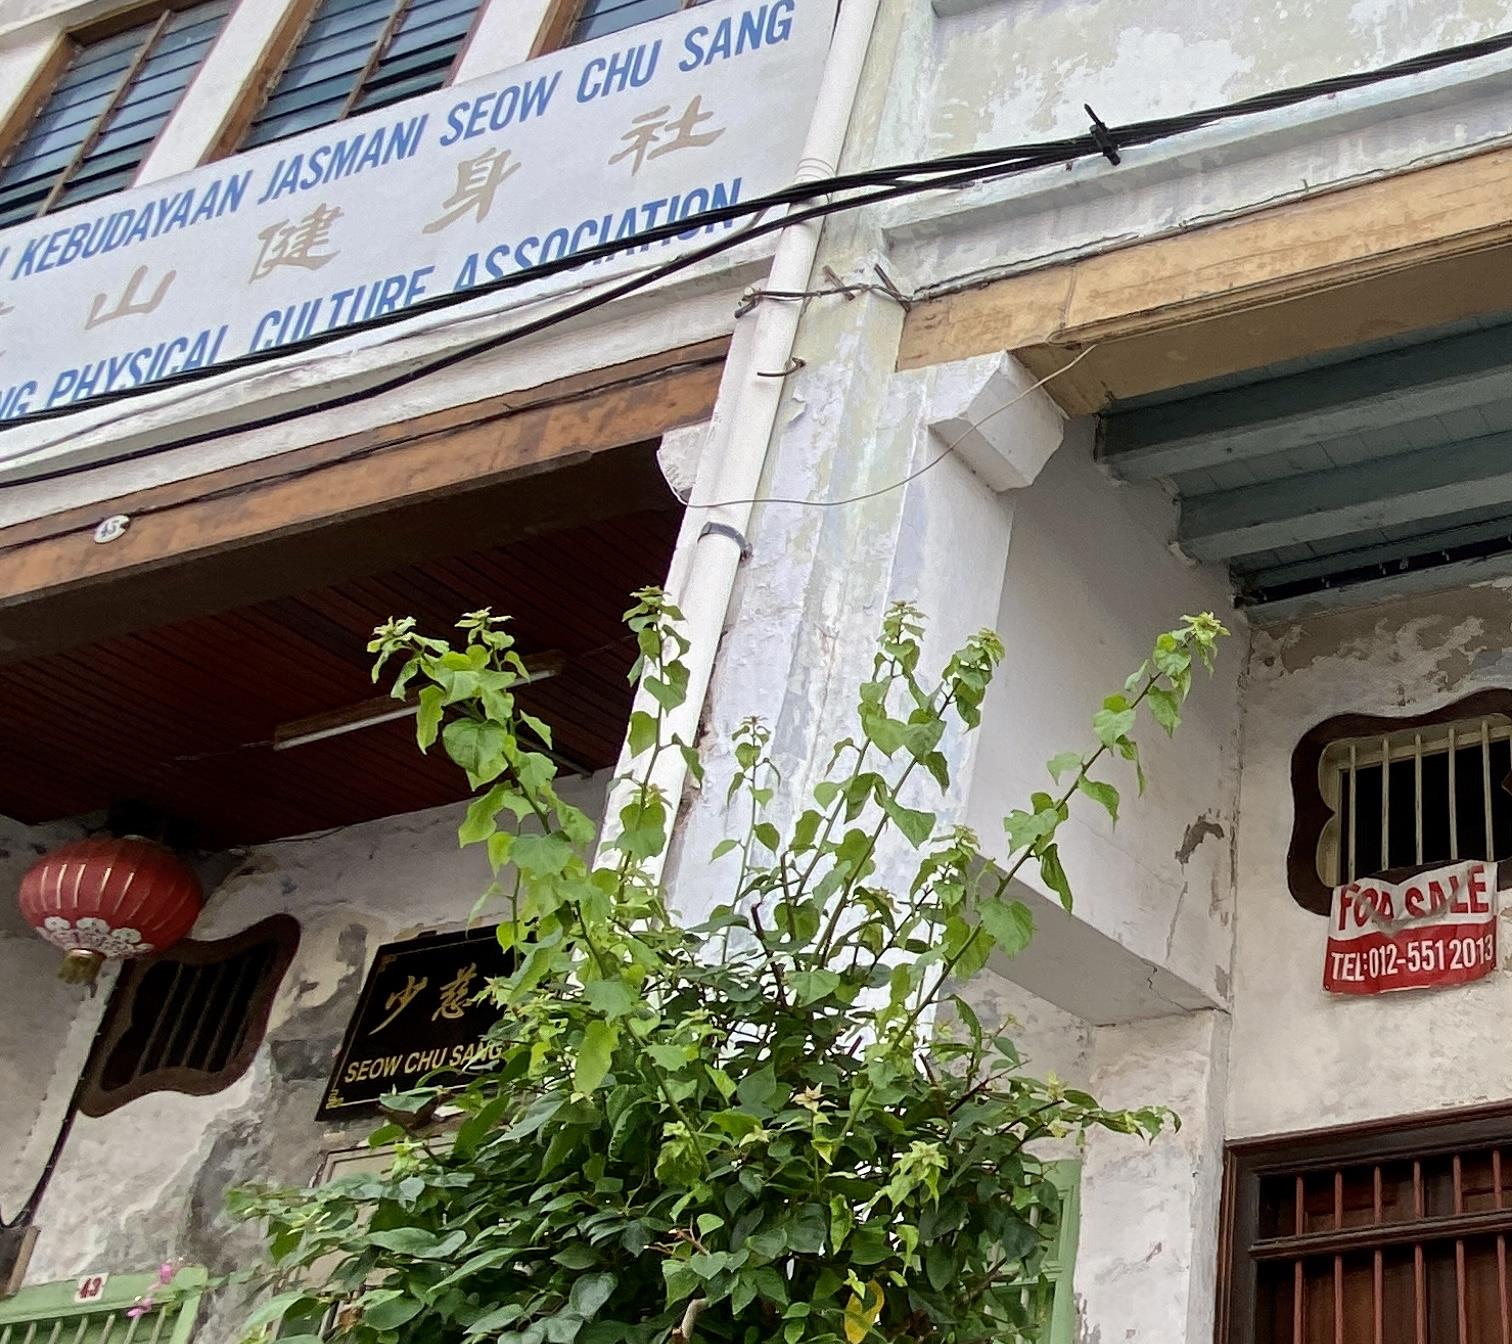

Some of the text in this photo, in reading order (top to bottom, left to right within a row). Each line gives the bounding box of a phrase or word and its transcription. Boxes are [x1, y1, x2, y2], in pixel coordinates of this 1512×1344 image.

[11, 170, 253, 280] KEBUDAYAAN
[257, 113, 430, 205] JASMANI
[440, 70, 563, 147] SEOW
[576, 39, 663, 103] CHU
[47, 324, 229, 408] PHYSICAL
[248, 265, 436, 353] CULTURE
[453, 177, 743, 292] ASSOCIATION
[1339, 865, 1489, 931] FOR SALE
[345, 1055, 403, 1083] SEOW
[404, 1047, 449, 1075] CHU
